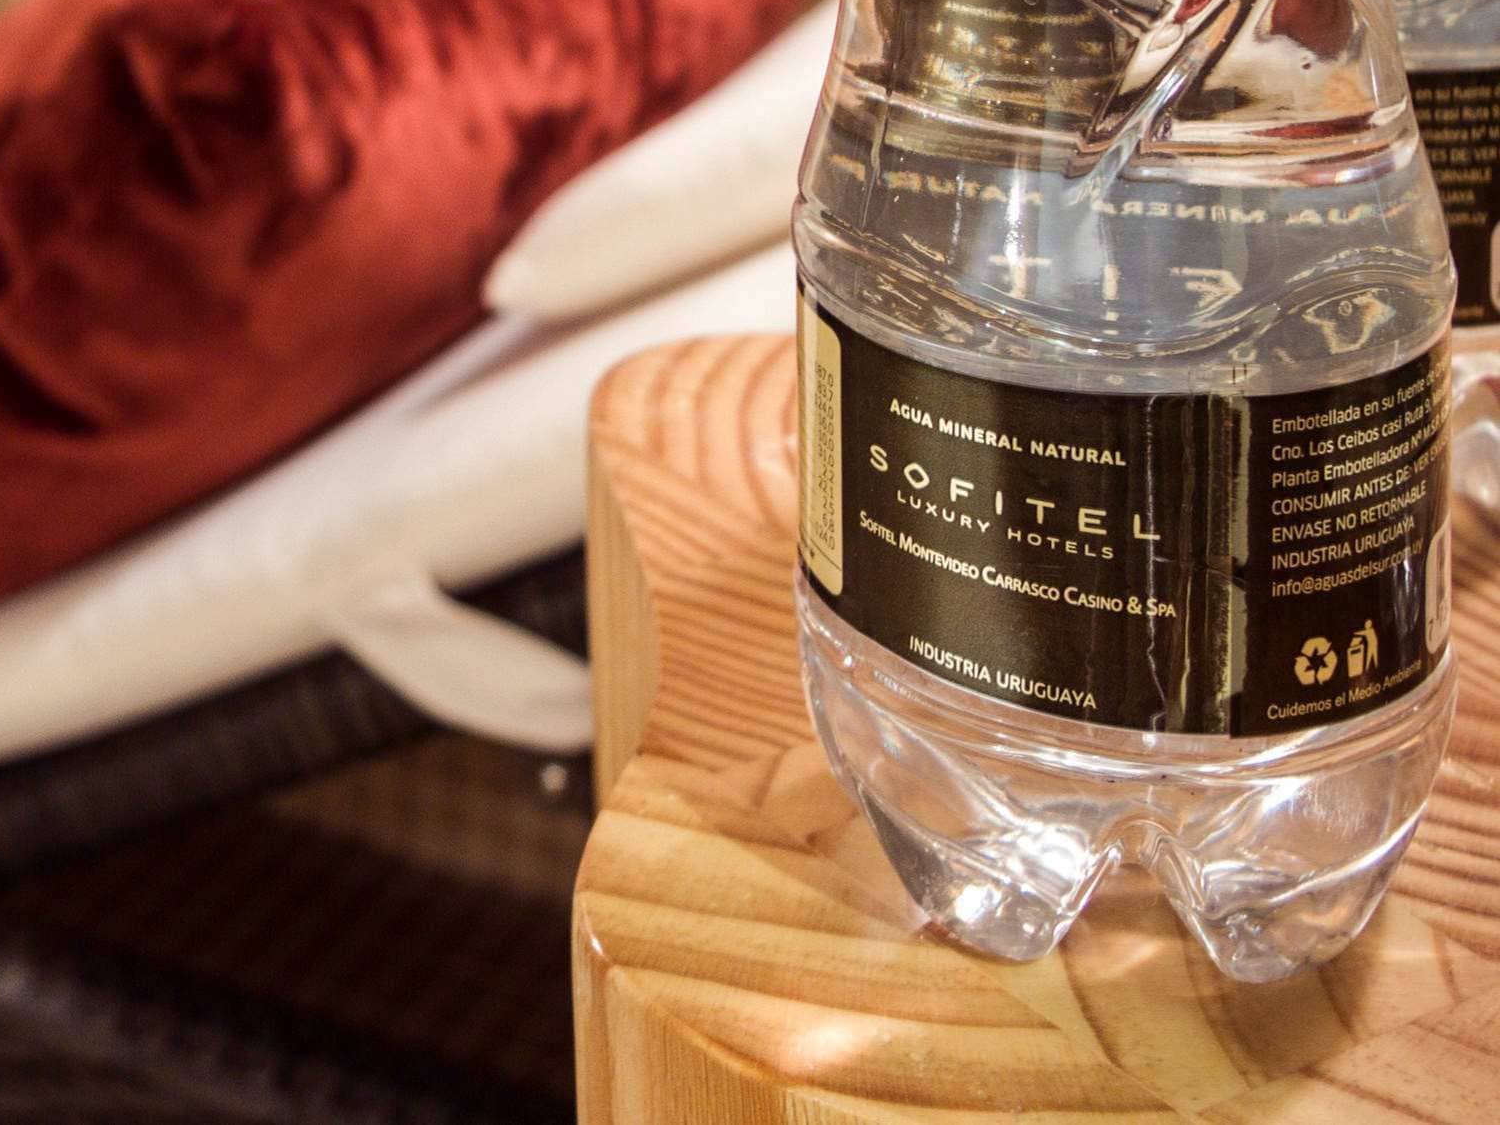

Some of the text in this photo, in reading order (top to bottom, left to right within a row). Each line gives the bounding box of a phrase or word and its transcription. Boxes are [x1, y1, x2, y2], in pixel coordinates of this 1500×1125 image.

[890, 398, 1127, 466] AGUA MINERAL NATURAL
[1271, 445, 1304, 462] Cno.
[1309, 441, 1335, 457] Los
[1337, 427, 1379, 451] Ceibos
[1381, 415, 1402, 437] casi
[1404, 406, 1425, 427] Ruta
[1272, 405, 1361, 434] Embotellada
[1363, 401, 1379, 417] en
[1381, 395, 1394, 410] su
[1396, 378, 1425, 404] fuente
[869, 444, 1161, 540] SOFITEL
[1272, 470, 1319, 488] Planta
[1323, 441, 1409, 481] Embotelladora
[1271, 488, 1351, 515] CONSUMIR
[1353, 474, 1394, 500] ANTES
[1272, 480, 1427, 543] ENVASE NO RETORNABLE
[897, 489, 1115, 559] LUXURY HOTELS
[1272, 516, 1415, 570] INDUSTRIA URUGUAYA
[1126, 596, 1143, 615] &
[909, 635, 1097, 710] INDUSTRIA URUGUAYA
[1267, 699, 1332, 720] Cuidemos
[1334, 692, 1346, 707] el
[1348, 682, 1381, 702] Medio
